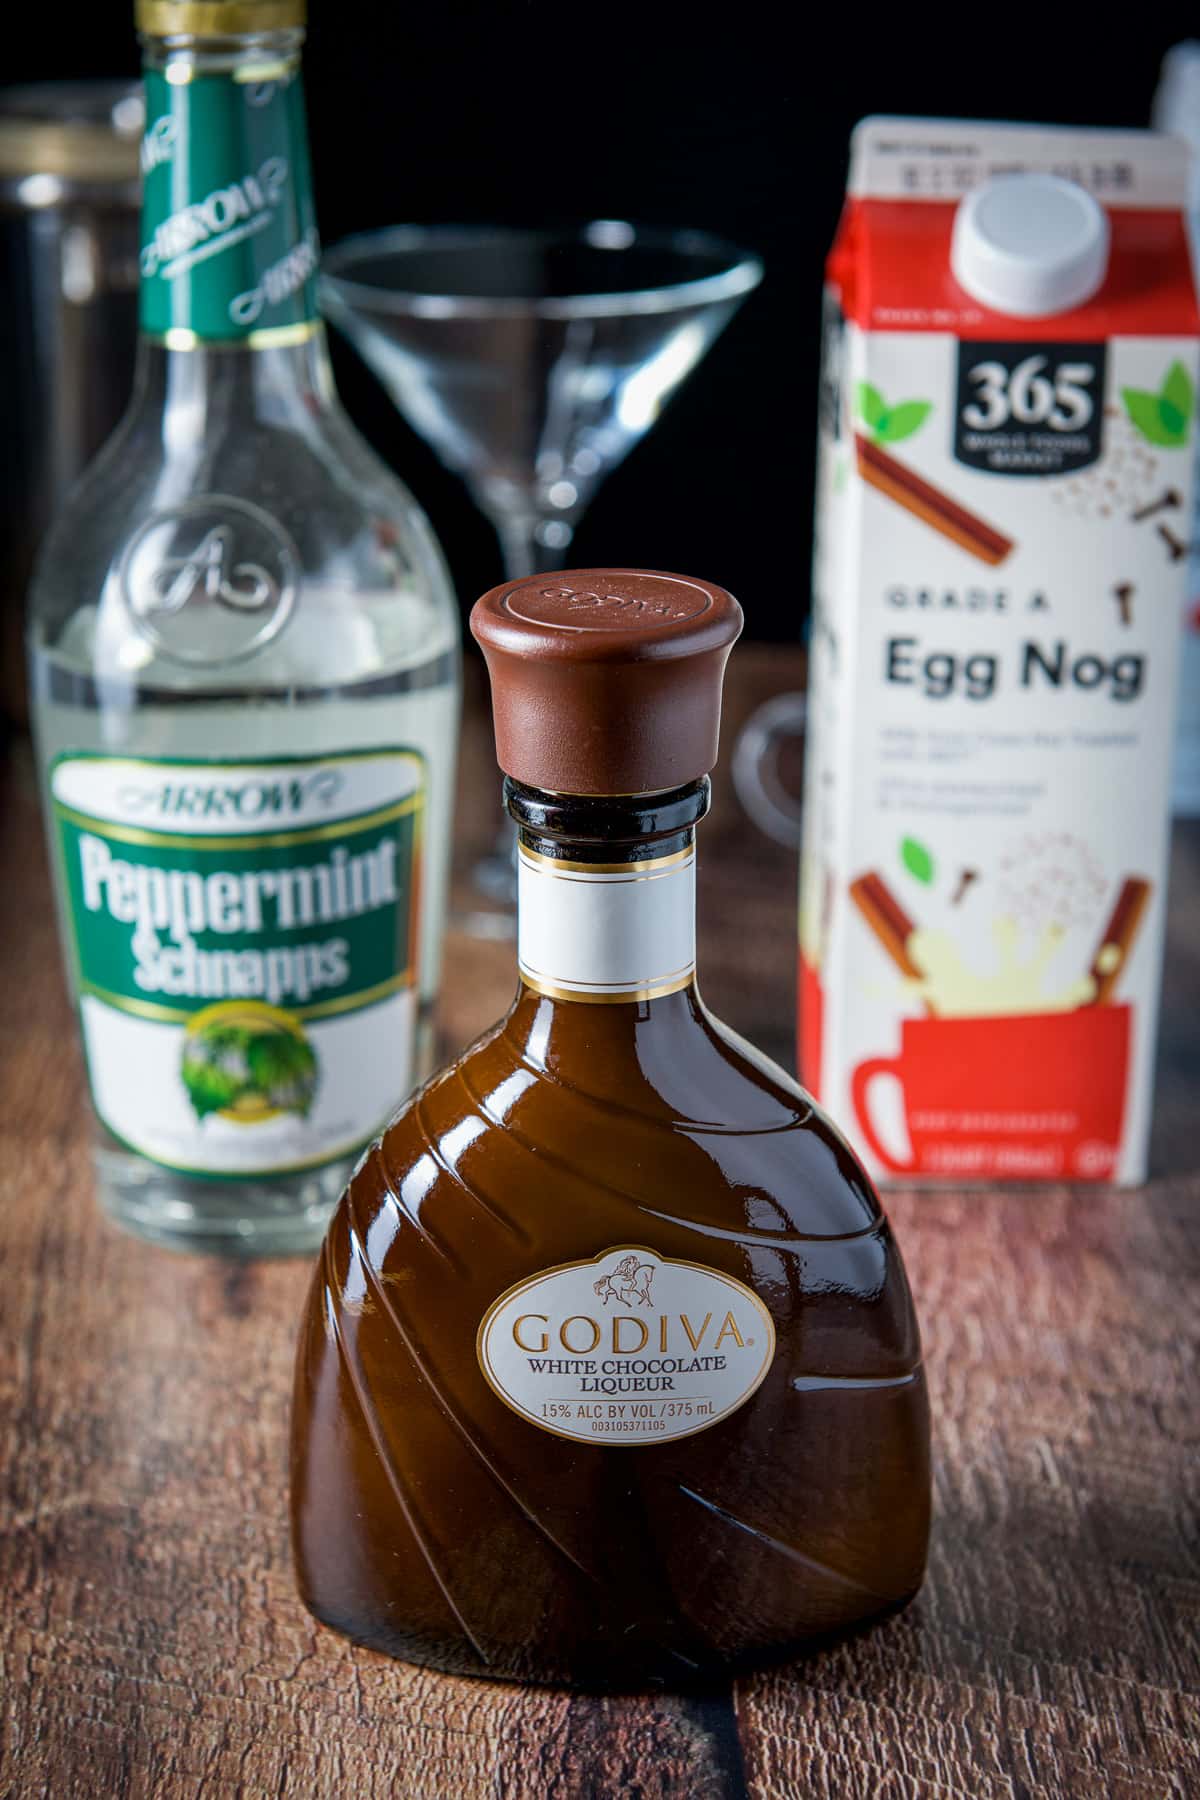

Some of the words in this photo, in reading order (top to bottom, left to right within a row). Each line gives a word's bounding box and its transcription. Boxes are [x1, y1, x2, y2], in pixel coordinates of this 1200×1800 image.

[961, 354, 1096, 432] 365
[886, 586, 1009, 612] GRADE
[1028, 588, 1051, 612] A
[885, 637, 999, 700] Egg
[1020, 640, 1147, 703] Nog
[117, 769, 345, 819] ARROW
[78, 835, 399, 941] Peppermint
[131, 930, 350, 1003] Schnapps
[527, 1358, 598, 1375] WHITE
[601, 1355, 727, 1376] CHOCOLATE
[580, 1377, 675, 1395] LIQUEUR
[542, 1403, 571, 1418] 15%
[577, 1405, 602, 1419] ALC
[608, 1405, 626, 1419] BY
[697, 1402, 716, 1415] mL
